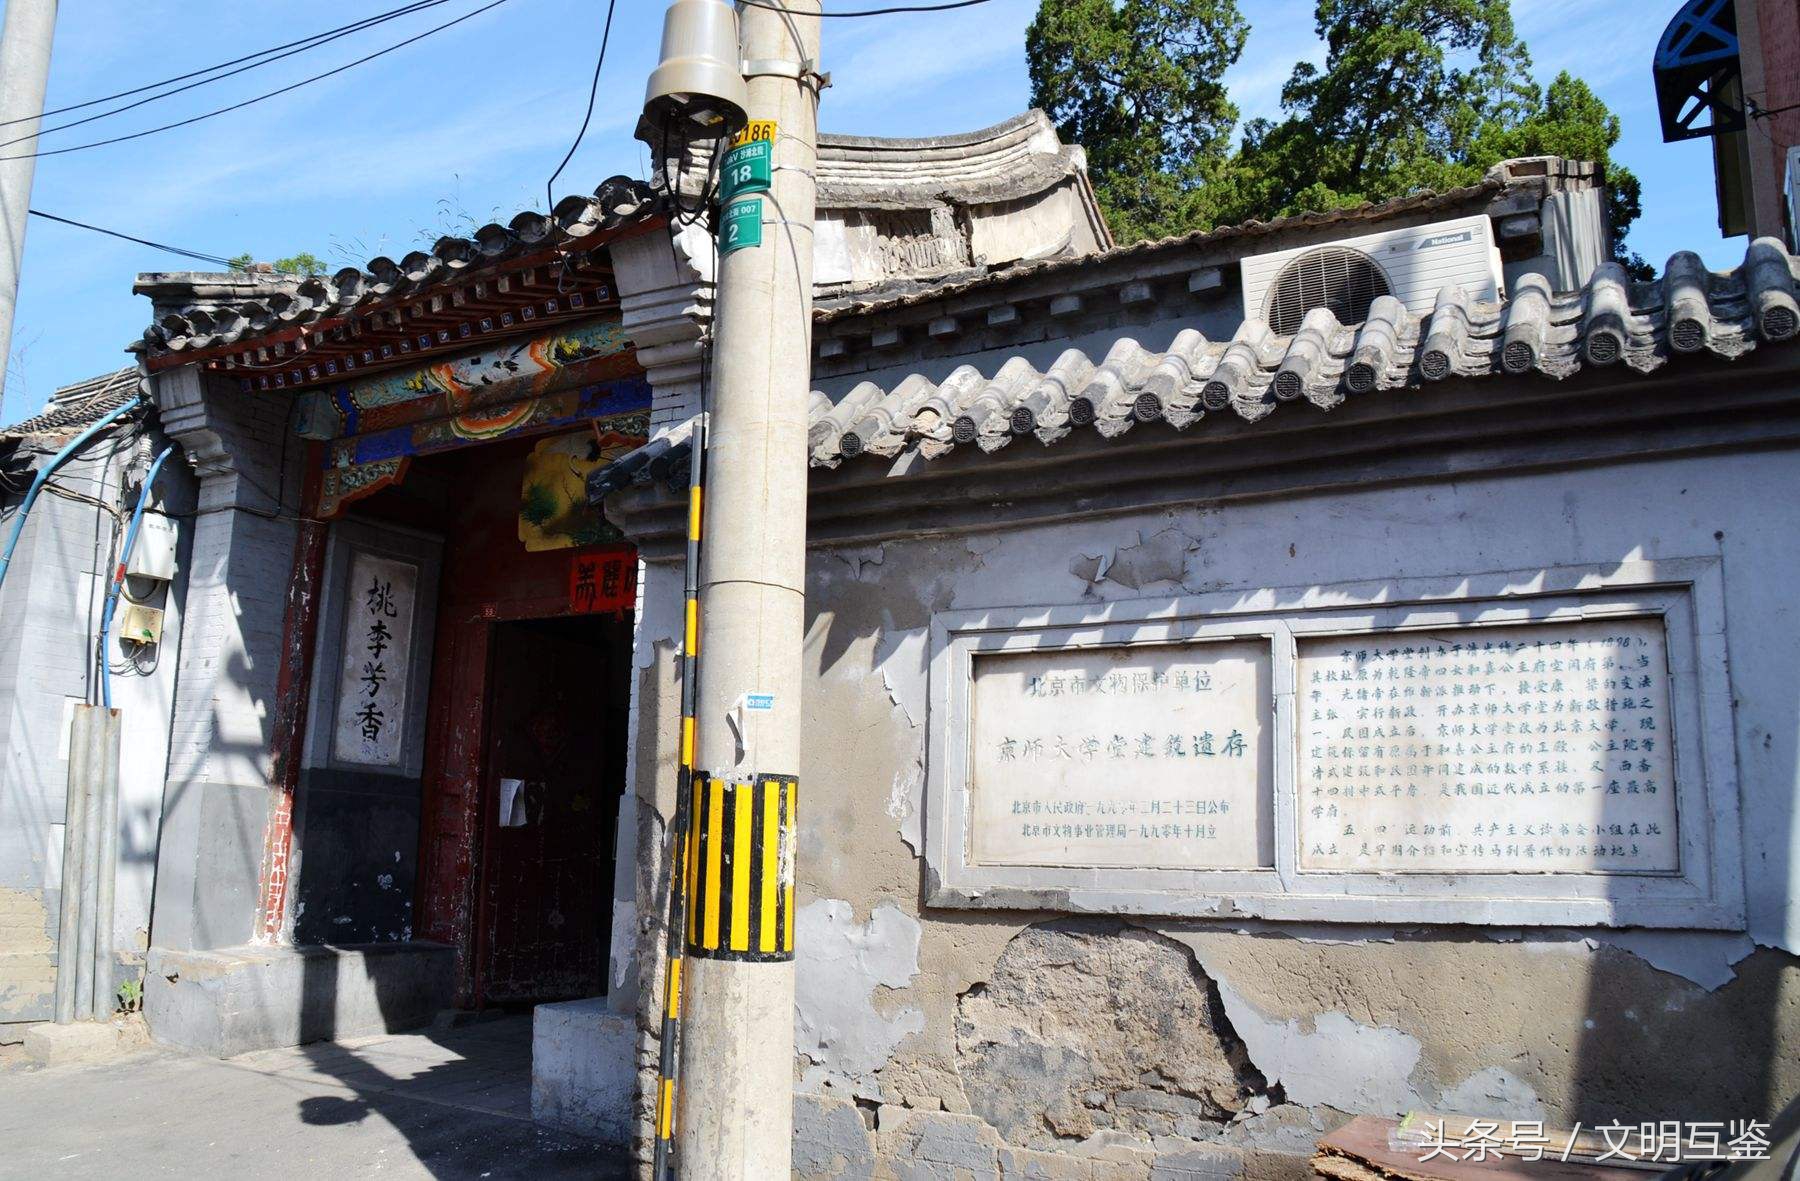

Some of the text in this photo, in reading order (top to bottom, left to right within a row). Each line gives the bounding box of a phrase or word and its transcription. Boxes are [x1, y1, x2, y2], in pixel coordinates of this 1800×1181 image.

[731, 165, 752, 186] 18
[741, 205, 756, 214] 007
[728, 223, 739, 243] 2
[1431, 233, 1464, 246] National
[355, 576, 398, 743] 桃李芳香
[1029, 670, 1214, 697] 北京市文物保护单位
[996, 729, 1248, 764] 京师大学堂建筑遗存
[1021, 823, 1217, 840] 北京市文物事业管理局一九九零年十月立
